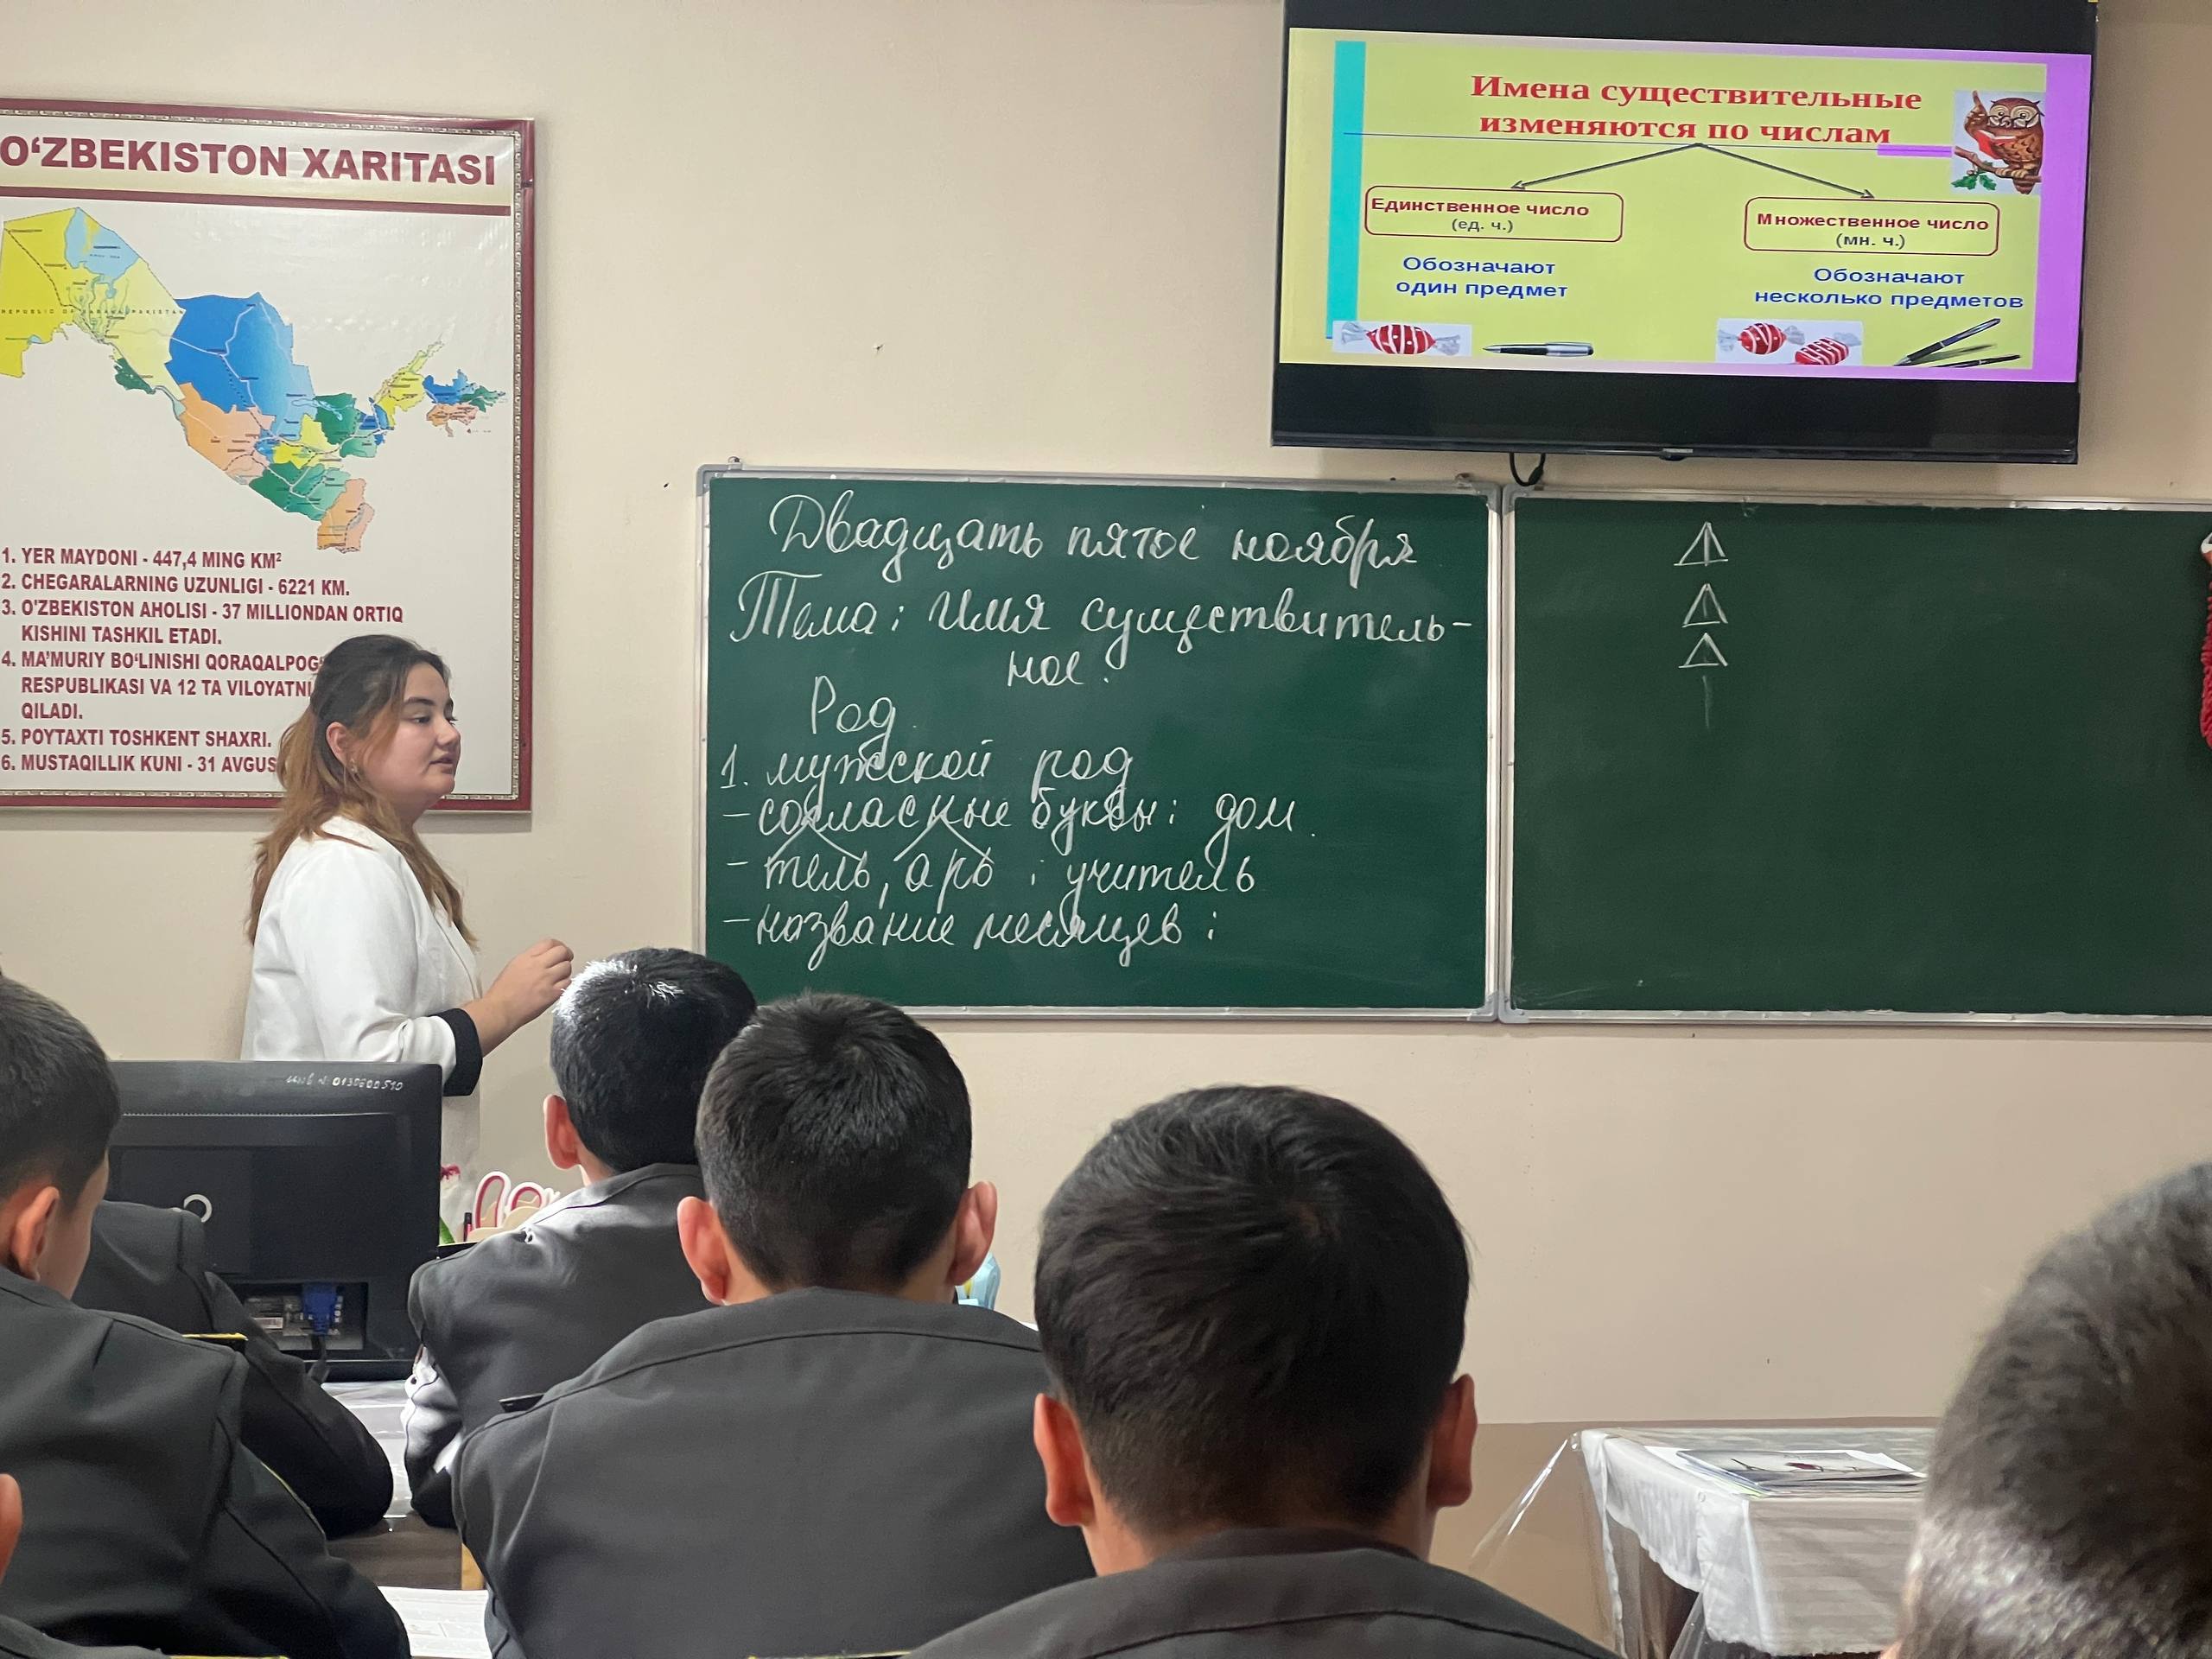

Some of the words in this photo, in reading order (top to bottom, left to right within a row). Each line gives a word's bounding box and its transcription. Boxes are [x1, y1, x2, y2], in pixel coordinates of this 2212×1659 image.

[1471, 74, 1591, 100] Имена
[1600, 82, 1923, 110] существительные
[1478, 114, 1697, 139] изменяются
[1707, 123, 1749, 140] по
[1759, 124, 1891, 144] числам
[302, 147, 496, 186] XARITASI
[1370, 197, 1521, 215] Единственное
[1525, 203, 1590, 217] число
[1452, 218, 1484, 232] (ед.
[1491, 219, 1514, 234] ч.)
[1757, 213, 1921, 230] Множественное
[1926, 217, 1990, 231] число
[1835, 232, 1876, 249] (мн.
[1882, 234, 1906, 251] ч.)
[1402, 256, 1556, 275] Обозначают
[1814, 267, 1966, 285] Обозначают
[1395, 281, 1458, 297] один
[1465, 283, 1569, 300] предмет
[1755, 289, 1883, 306] несколько
[1891, 294, 2024, 310] предметов
[768, 489, 1044, 583] Двадцать
[1066, 521, 1201, 561] пятое
[1230, 514, 1418, 589] ноября
[2, 547, 16, 563] 1.
[22, 547, 55, 564] YER
[60, 548, 137, 566] MAYDONI
[153, 550, 197, 571] 447,4
[202, 551, 245, 569] MING
[1, 572, 16, 589] 2.
[22, 573, 179, 593] CHEGARALARNING
[184, 576, 263, 594] UZUNLIGI
[278, 578, 315, 595] 6221
[321, 579, 350, 596] KM.
[2, 598, 16, 615] 3.
[22, 599, 134, 617] O'ZBEKISTON
[140, 601, 207, 619] AHOLISI
[222, 603, 241, 620] 37
[246, 603, 347, 622] MILLIONDAN
[353, 605, 404, 623] ORTIQ
[22, 625, 86, 642] KISHINI
[92, 626, 164, 644] TASHKIL
[168, 627, 222, 645] ETADI.
[1, 650, 16, 667] 4.
[22, 677, 144, 695] RESPUBLIKASI
[149, 678, 173, 695] VA
[178, 678, 197, 696] 12
[201, 679, 222, 696] TA
[22, 702, 83, 720] QILADI.
[1, 728, 16, 745] 5.
[22, 728, 104, 746] POYTAXTI
[110, 729, 200, 747] TOSHKENT
[206, 730, 272, 747] SHAXRI.
[1, 753, 16, 771] 6.
[22, 754, 135, 772] MUSTAQILLIK
[141, 755, 182, 772] KUNI
[198, 756, 215, 772] 31
[721, 743, 749, 789] 1.
[1031, 746, 1134, 812] род
[1067, 855, 1255, 931] учитель
